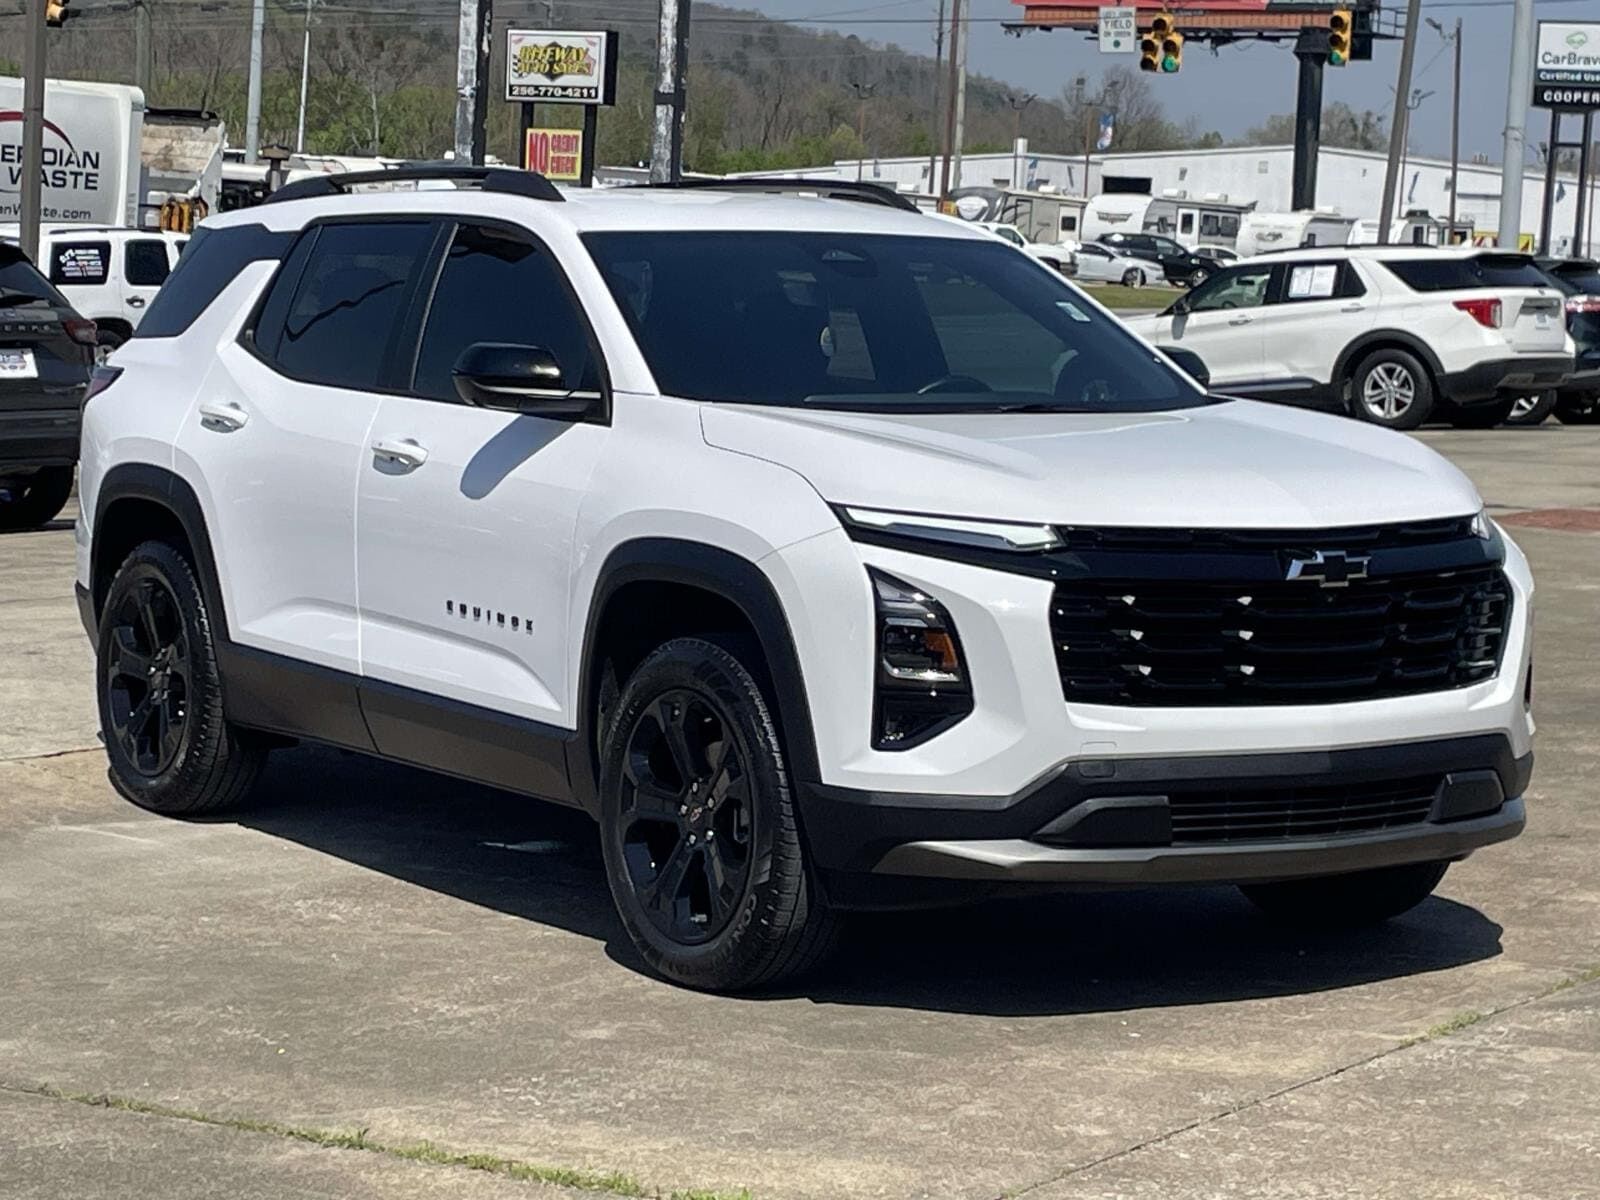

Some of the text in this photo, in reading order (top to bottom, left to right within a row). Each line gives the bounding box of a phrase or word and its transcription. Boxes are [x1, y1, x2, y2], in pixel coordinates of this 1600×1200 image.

[1104, 19, 1132, 29] YIELD
[512, 86, 596, 98] 256-770-4211
[1543, 90, 1600, 104] COOPER
[529, 132, 549, 172] NO
[446, 600, 534, 632] EQUINOX
